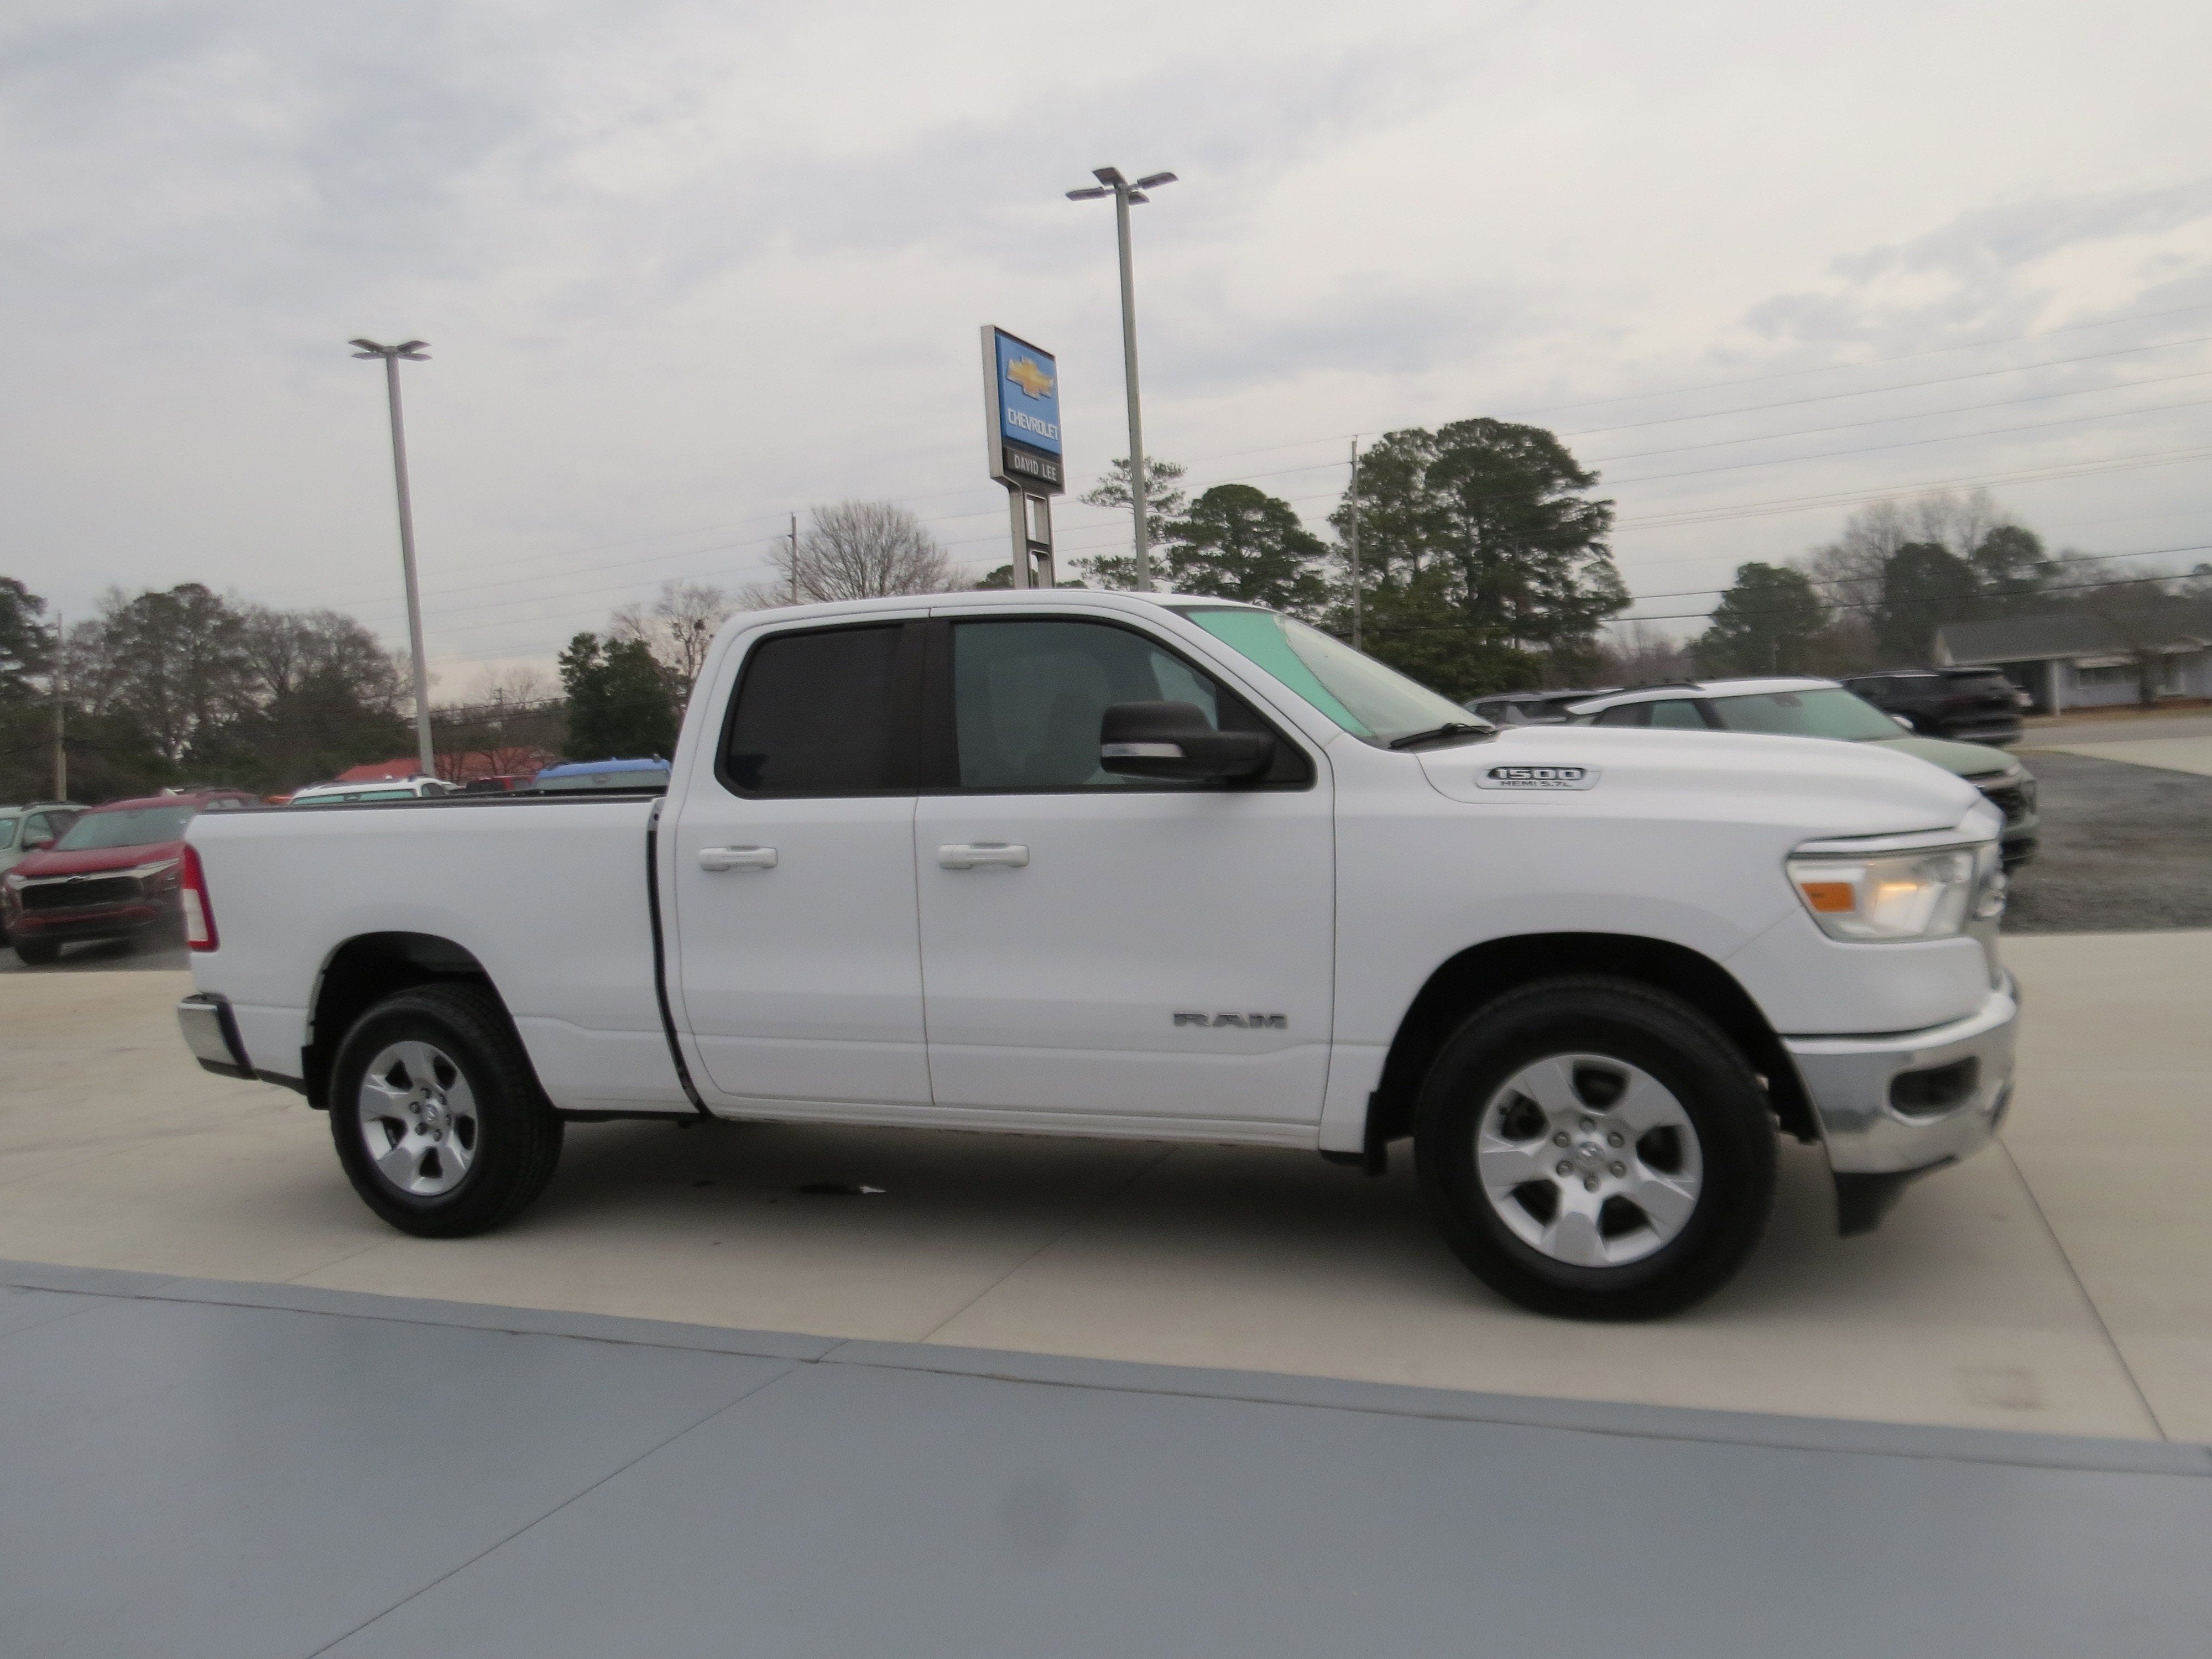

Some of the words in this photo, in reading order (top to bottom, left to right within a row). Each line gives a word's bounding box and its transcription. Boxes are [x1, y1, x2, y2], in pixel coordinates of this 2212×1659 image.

[1008, 408, 1058, 440] CHEVROLET
[1014, 454, 1039, 475] DAVID
[1042, 463, 1057, 482] LEE
[1497, 769, 1581, 779] 1500
[1173, 1013, 1287, 1029] RAM
